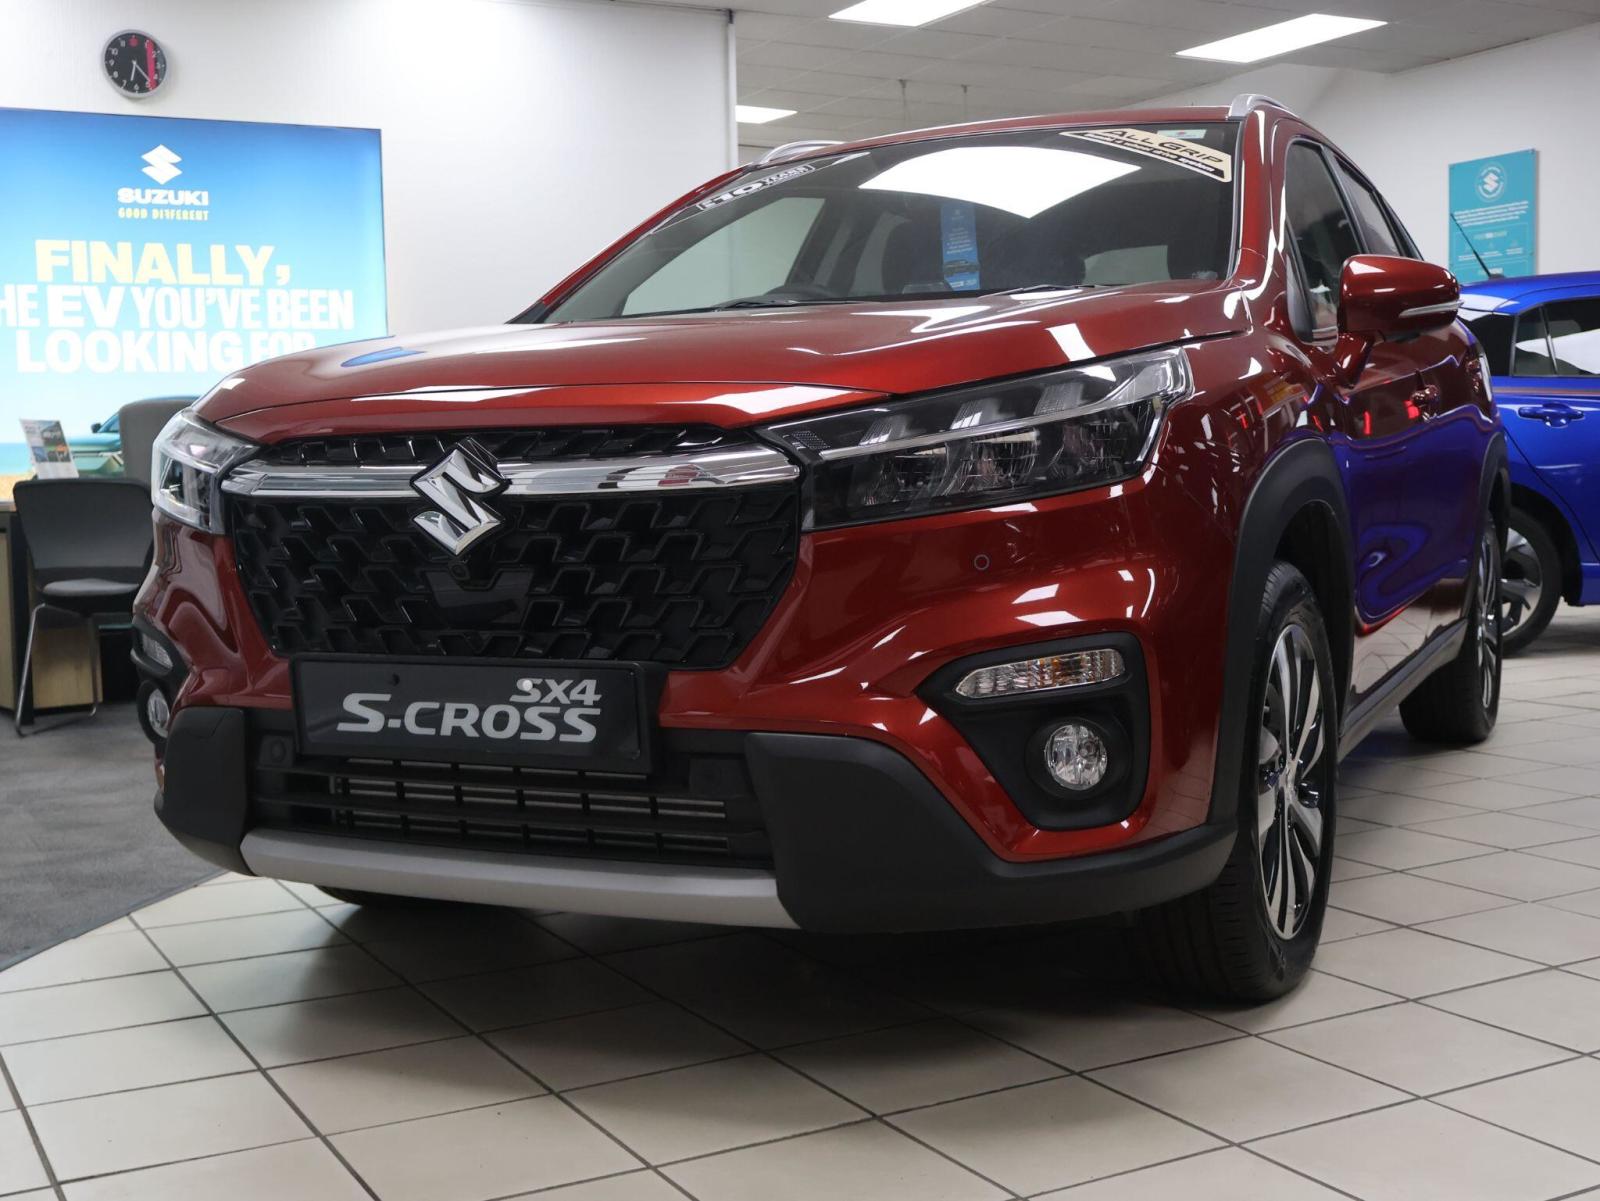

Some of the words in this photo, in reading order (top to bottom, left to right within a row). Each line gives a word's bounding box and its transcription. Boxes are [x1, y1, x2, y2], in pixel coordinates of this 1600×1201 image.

[117, 187, 209, 206] SUZUKI
[118, 207, 148, 219] GOOD
[151, 208, 209, 221] DIFFERENT
[35, 240, 290, 286] FINALLY,
[0, 284, 41, 328] HE
[47, 284, 126, 328] EV
[131, 286, 262, 330] YOU'VE
[266, 288, 355, 331] BEEN
[15, 329, 244, 374] LOOKING
[509, 678, 602, 705] SX4
[336, 693, 601, 743] S-CROSS
